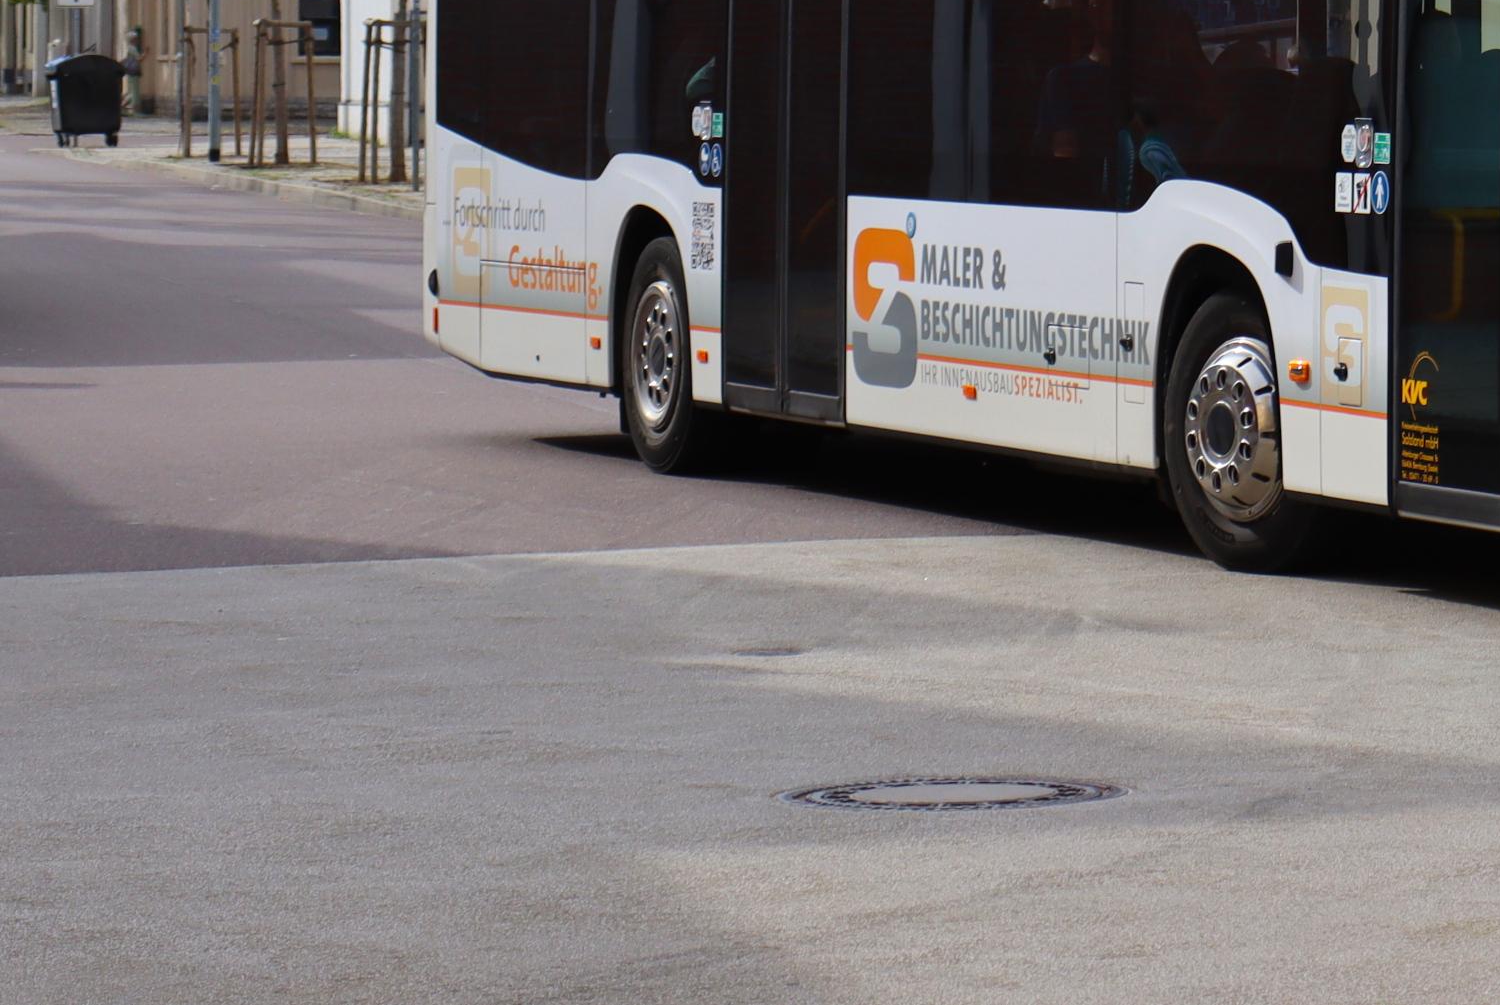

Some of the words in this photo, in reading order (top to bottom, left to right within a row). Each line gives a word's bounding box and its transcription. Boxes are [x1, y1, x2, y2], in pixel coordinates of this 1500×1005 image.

[453, 196, 511, 230] Fortschritt
[513, 198, 546, 232] durch
[508, 244, 603, 310] Gestaltung.
[920, 243, 984, 289] MALER
[992, 249, 1006, 291] &
[920, 299, 1150, 366] BESCHICHTUNGSTECHNIK
[920, 363, 938, 385] IHR
[1401, 378, 1428, 405] KVC
